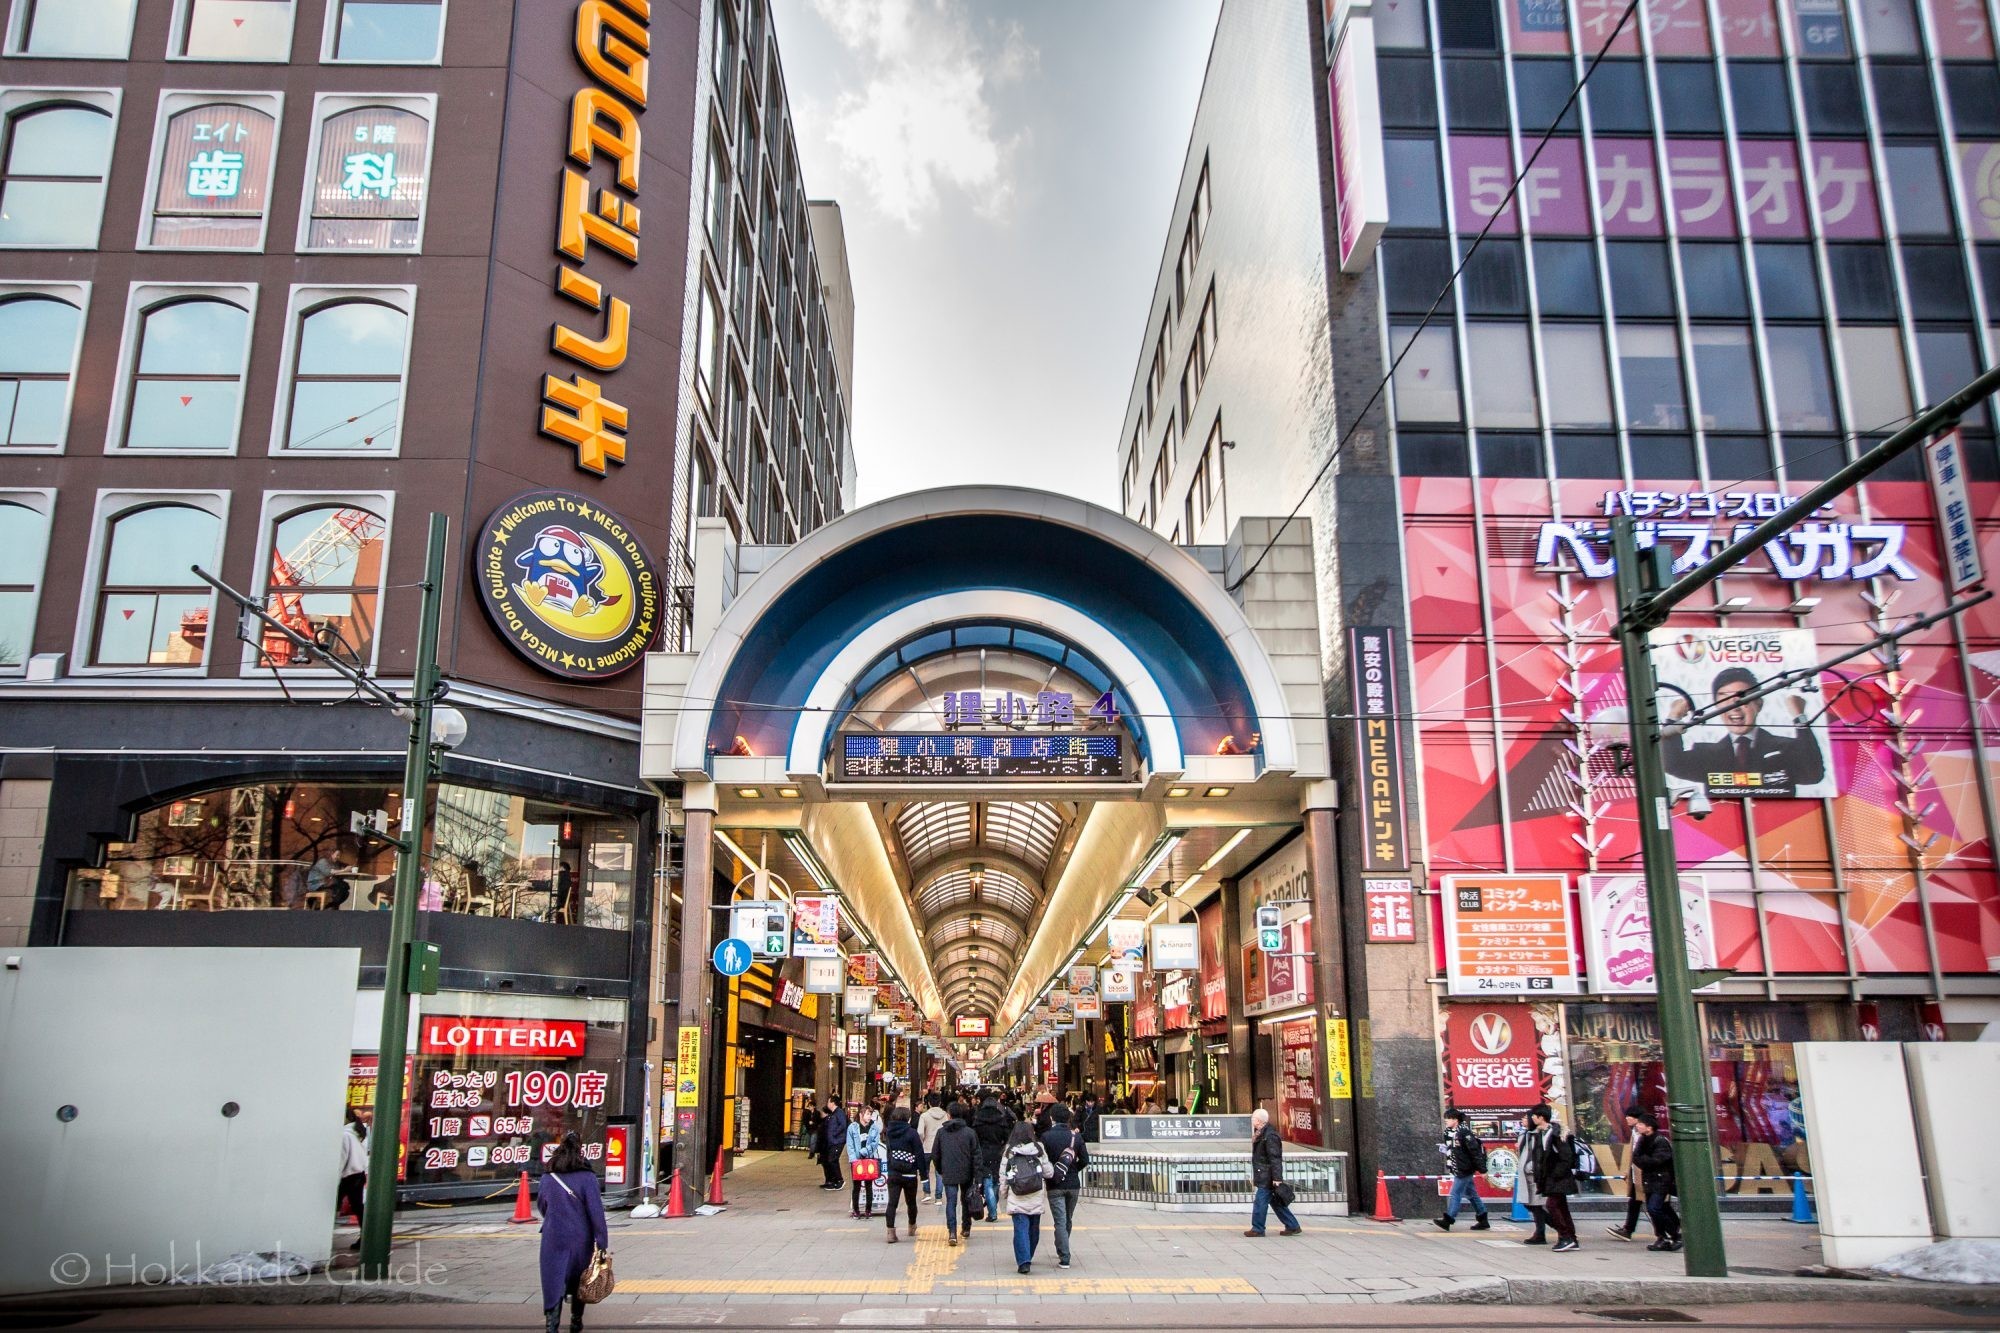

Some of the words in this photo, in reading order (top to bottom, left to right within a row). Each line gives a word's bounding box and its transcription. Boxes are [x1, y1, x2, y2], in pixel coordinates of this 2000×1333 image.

[1806, 25, 1838, 44] 6F
[193, 122, 249, 143] エイト
[187, 150, 243, 198] 歯
[341, 152, 397, 198] 科
[1600, 155, 1869, 225] カラオケ
[500, 498, 556, 532] Welcome
[557, 497, 575, 513] To
[593, 510, 627, 545] MEGA
[625, 542, 645, 570] Don
[486, 545, 508, 599] Quijote
[638, 571, 656, 620] Quijote
[500, 604, 524, 632] Don
[520, 628, 559, 663] MEGA
[597, 634, 647, 668] Welcome
[1707, 640, 1782, 652] VEGAS
[578, 656, 596, 671] To
[1709, 651, 1784, 663] VEGAS
[943, 691, 1075, 724] 狸小路
[1089, 692, 1120, 724] 4
[1367, 719, 1395, 861] MEGAドンキ
[1459, 891, 1479, 901] 快活
[1482, 888, 1528, 899] コミック
[1483, 900, 1562, 912] インターネット
[1370, 906, 1387, 936] 本店
[1395, 905, 1413, 936] 北館
[1478, 937, 1546, 946] ファミリールーム
[1476, 951, 1551, 960] ダーツ・ビリヤード
[1531, 978, 1549, 988] 6F
[430, 1025, 577, 1048] LOTTERIA
[680, 1031, 691, 1075] 通行禁止
[433, 1070, 497, 1088] ゆったり
[1456, 1063, 1534, 1077] VEGAS
[504, 1070, 608, 1108] 190席
[1457, 1075, 1534, 1089] VEGAS
[430, 1090, 482, 1109] 座れる
[429, 1117, 462, 1138] 1階
[493, 1116, 533, 1134] 65席
[1151, 1120, 1182, 1128] POLE
[1188, 1120, 1221, 1128] TOWN
[424, 1148, 460, 1169] 2階
[491, 1146, 531, 1165] 80席
